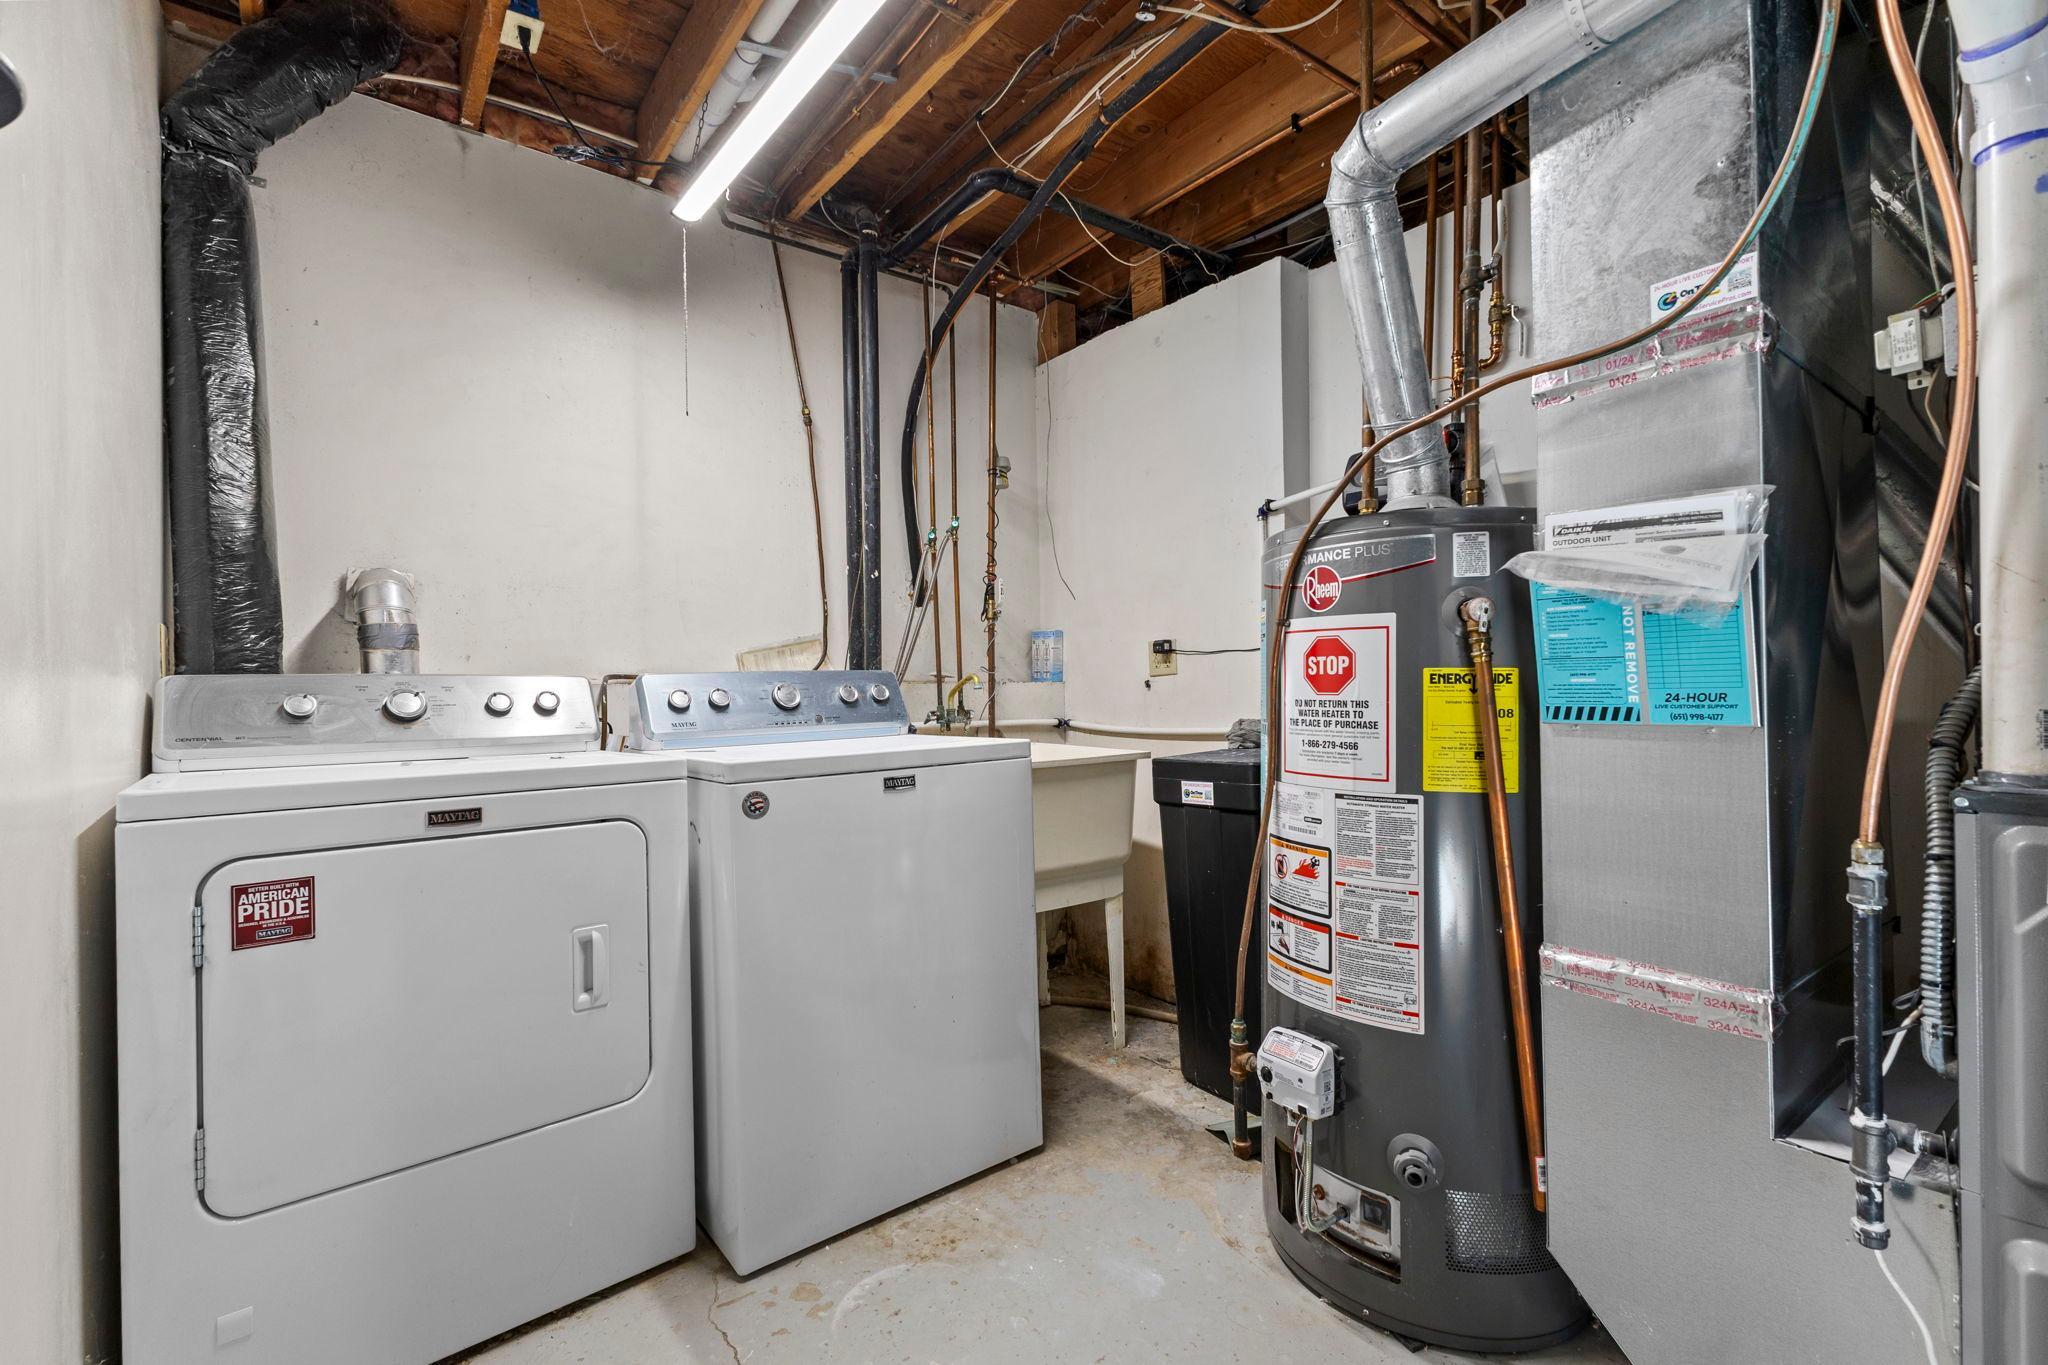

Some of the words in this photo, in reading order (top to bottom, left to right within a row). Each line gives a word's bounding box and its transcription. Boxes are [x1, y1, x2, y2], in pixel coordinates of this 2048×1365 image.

[1605, 355, 1634, 371] 01/24
[1609, 371, 1638, 388] 01/24
[1560, 525, 1593, 535] DAIKIN
[1552, 538, 1591, 547] OUTDOOR
[1593, 535, 1612, 544] UNIT
[1306, 566, 1340, 605] Rheem
[1622, 606, 1635, 636] NOT
[1308, 655, 1350, 675] STOP
[1624, 641, 1639, 703] REMOVE
[1295, 699, 1303, 708] DO
[1304, 699, 1317, 708] NOT
[1318, 699, 1348, 709] RETURN
[1350, 700, 1369, 709] THIS
[1664, 692, 1728, 703] 24-HOUR
[1298, 709, 1320, 718] WATER
[1321, 710, 1351, 719] HEATER
[1352, 710, 1364, 719] TO
[1669, 713, 1688, 721] (651)
[1689, 713, 1724, 721] 998-4177
[1289, 718, 1300, 727] THE
[1300, 719, 1321, 728] PLACE
[1323, 719, 1333, 728] OF
[1334, 720, 1379, 730] PURCHASE
[1301, 739, 1359, 751] 1-866-279-4566
[886, 777, 915, 788] MAYTAG
[430, 810, 480, 824] MAYTAG
[248, 885, 269, 893] BETTER
[269, 883, 285, 891] BUILT
[238, 886, 309, 906] AMERICAN
[237, 896, 310, 923] PRIDE
[258, 927, 291, 938] MAYTAG
[1626, 960, 1656, 973] 324A
[1624, 977, 1655, 992] 324A
[1627, 998, 1658, 1013] 324A
[1703, 997, 1738, 1012] 324A
[1707, 1019, 1741, 1035] 324A
